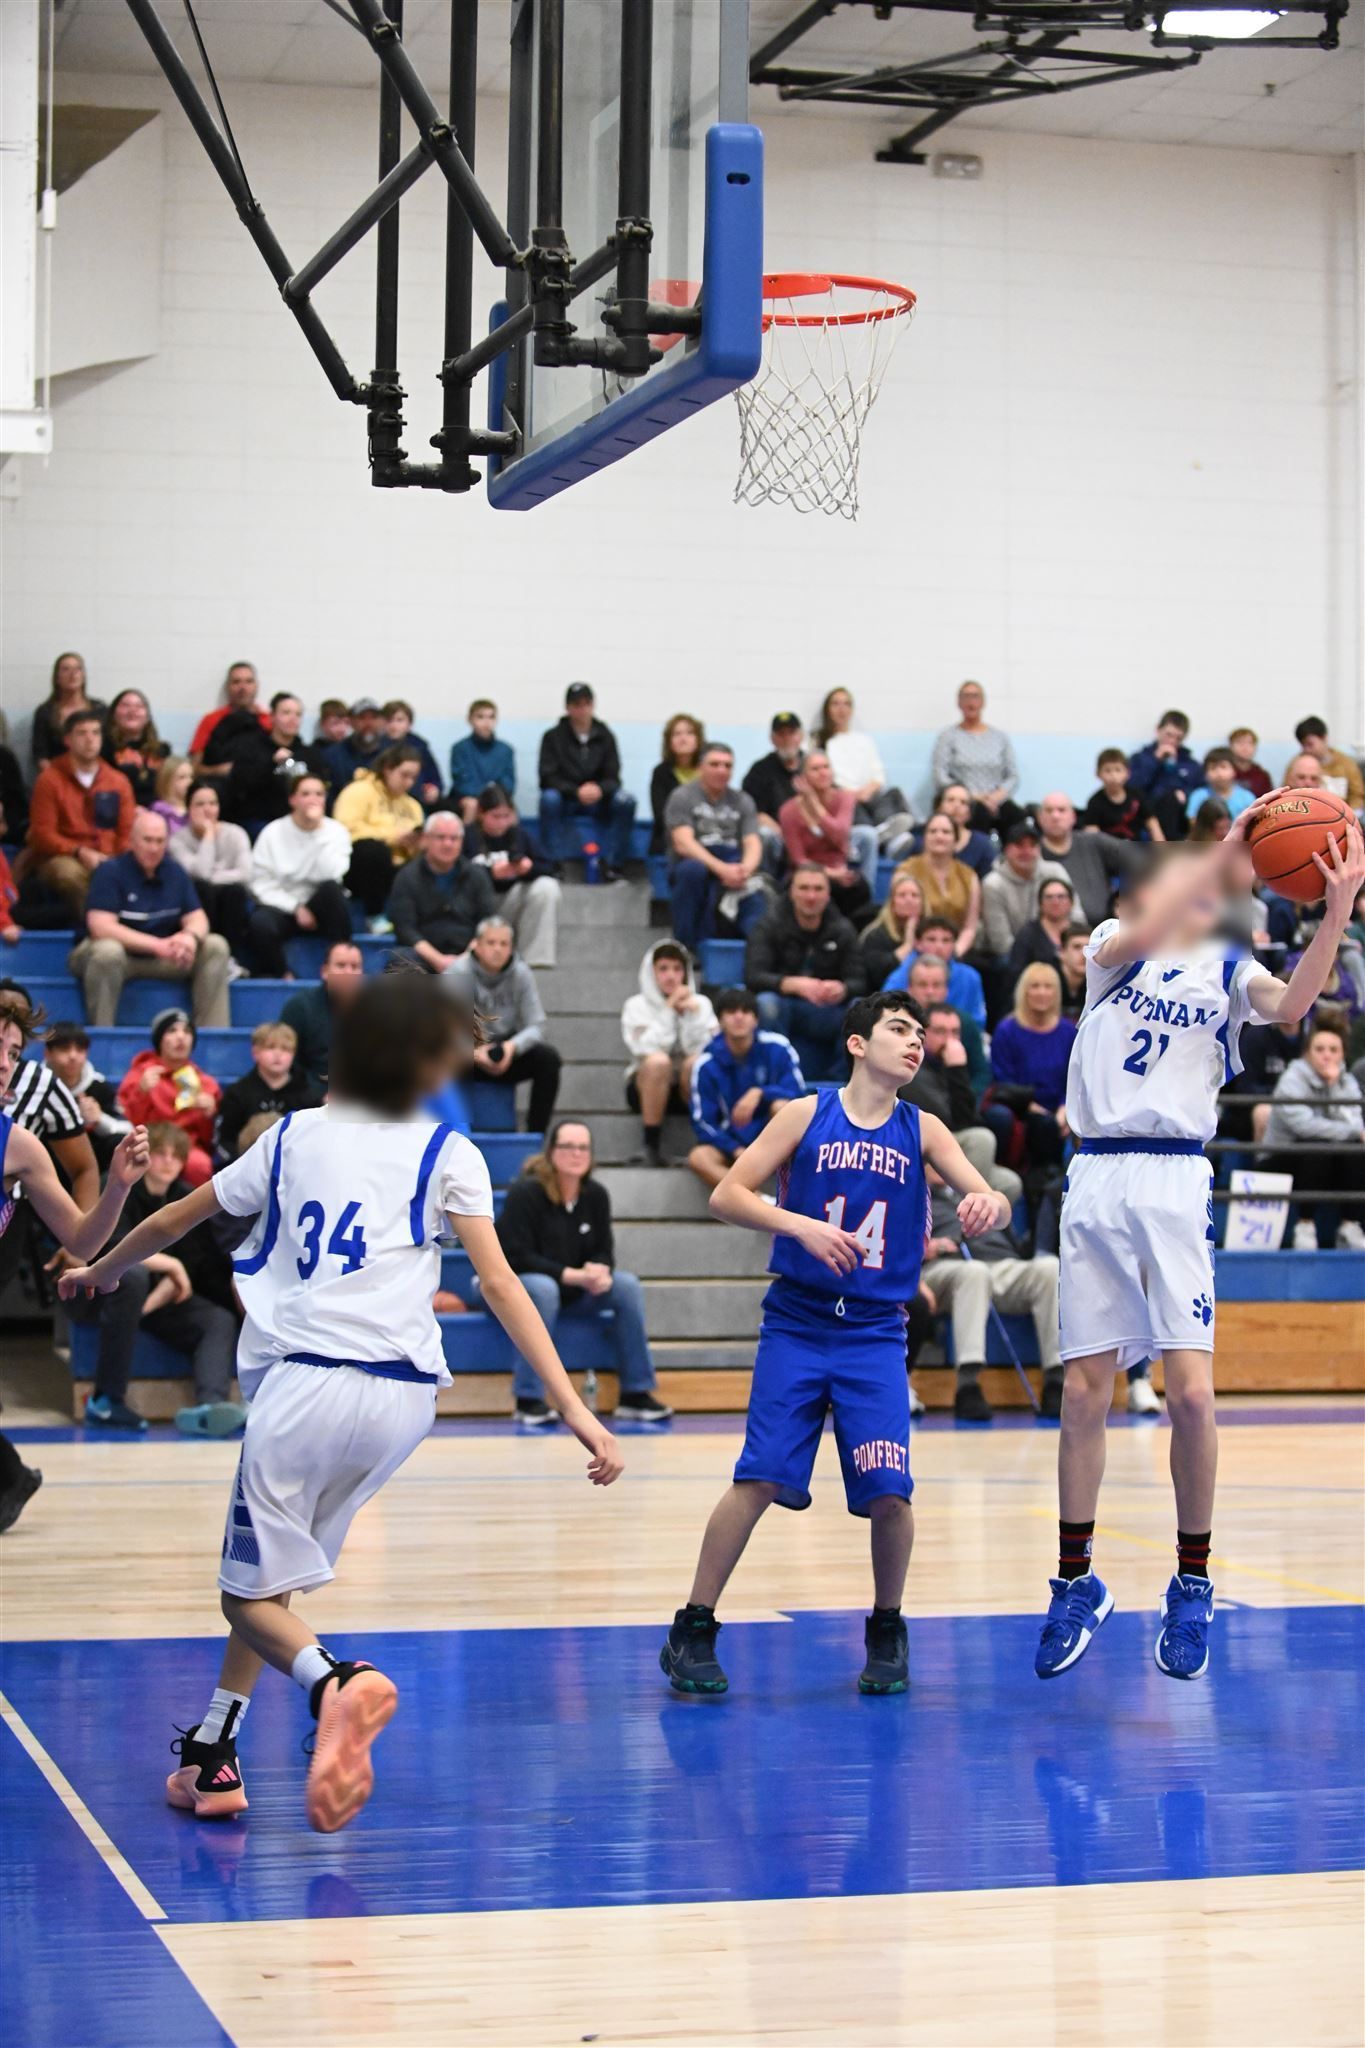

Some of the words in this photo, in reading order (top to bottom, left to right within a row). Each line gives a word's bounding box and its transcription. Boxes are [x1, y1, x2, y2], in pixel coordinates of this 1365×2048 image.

[815, 1141, 910, 1185] POMFRET
[296, 1200, 367, 1280] 34
[824, 1194, 887, 1269] 14
[853, 1440, 907, 1477] POMFRET
